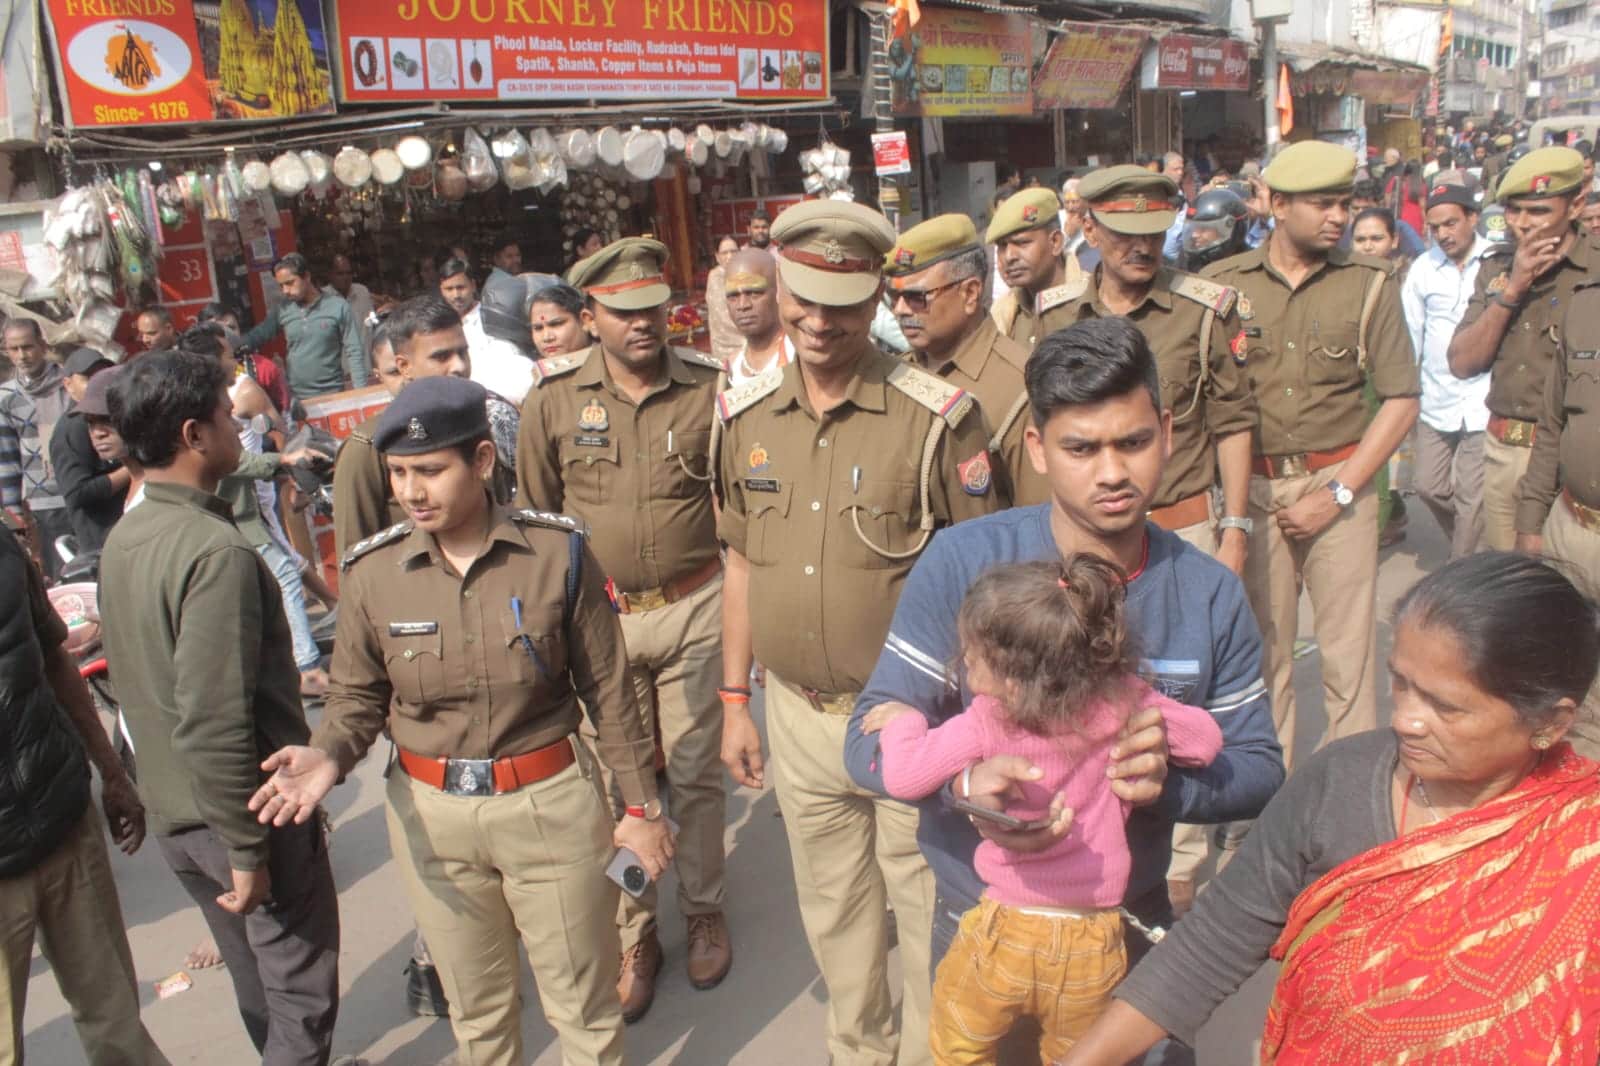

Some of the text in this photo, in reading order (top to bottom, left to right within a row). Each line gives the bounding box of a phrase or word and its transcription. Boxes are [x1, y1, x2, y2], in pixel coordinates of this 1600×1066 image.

[65, 0, 176, 17] FRIENDS
[398, 0, 795, 37] JOURNEY FRIENDS
[494, 35, 736, 57] Phool Maala, Locker Facility, Rudraksh, Brass Idol
[515, 56, 722, 76] Spatik, Shankh, Copper Items & Puja Items
[93, 101, 190, 123] Since- 1976
[179, 259, 203, 283] 33
